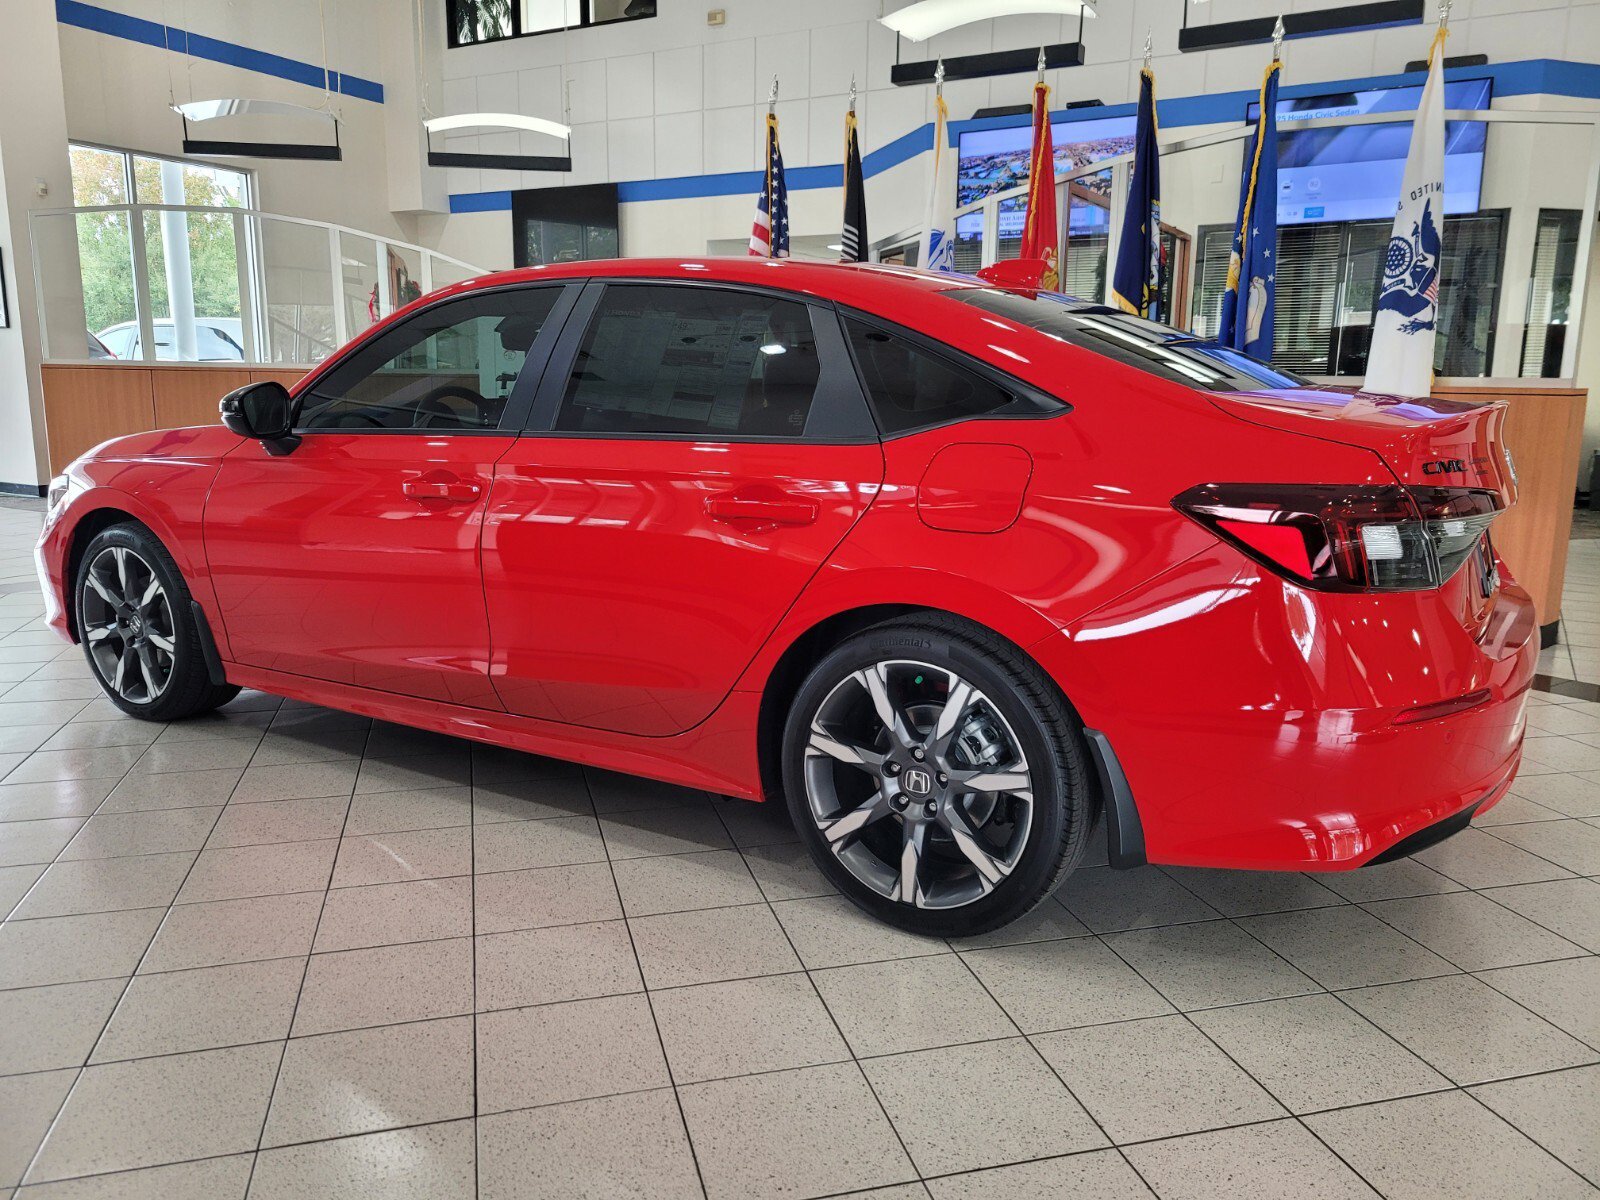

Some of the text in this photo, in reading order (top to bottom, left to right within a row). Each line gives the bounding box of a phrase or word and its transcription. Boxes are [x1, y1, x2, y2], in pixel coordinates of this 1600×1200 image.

[1288, 113, 1313, 121] Honda
[1335, 108, 1360, 117] Sedan
[1422, 459, 1468, 475] CIVIC
